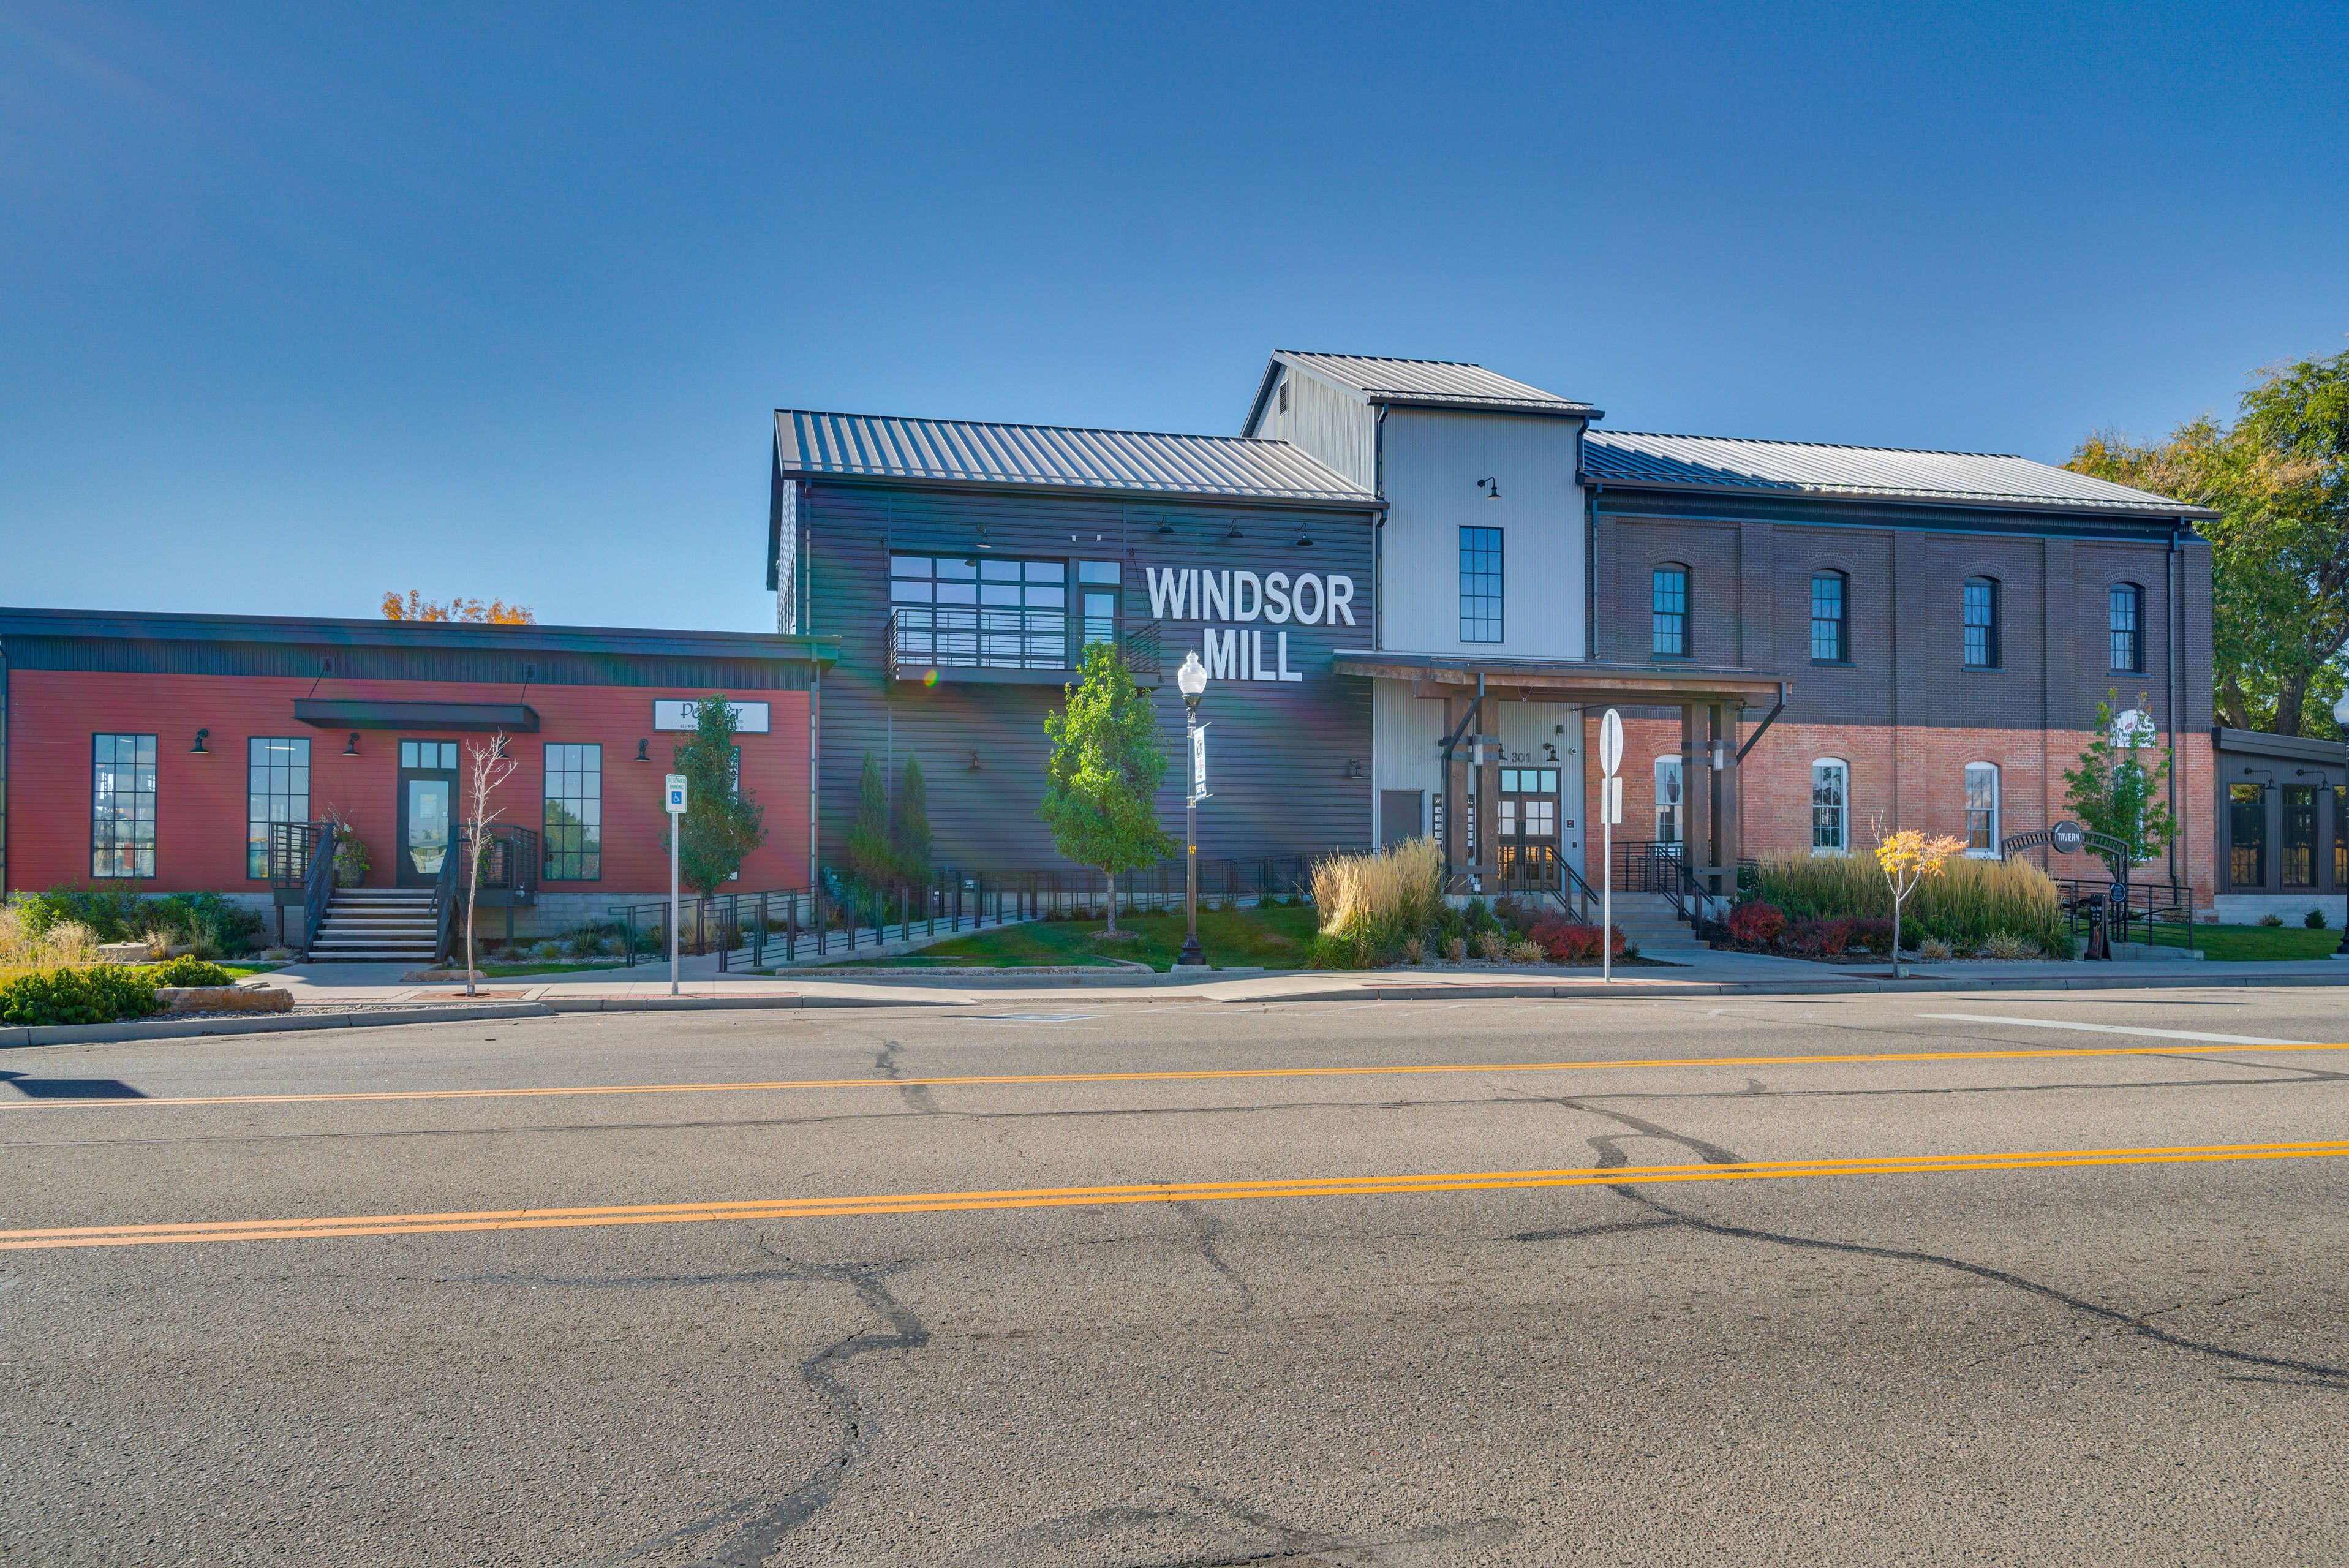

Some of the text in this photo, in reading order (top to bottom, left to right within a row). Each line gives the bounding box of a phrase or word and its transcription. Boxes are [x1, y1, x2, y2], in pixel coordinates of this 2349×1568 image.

[1145, 567, 1356, 625] WINDSOR
[1204, 628, 1302, 682] MILL
[1512, 753, 1529, 763] 301
[2057, 832, 2079, 842] TAVERN
